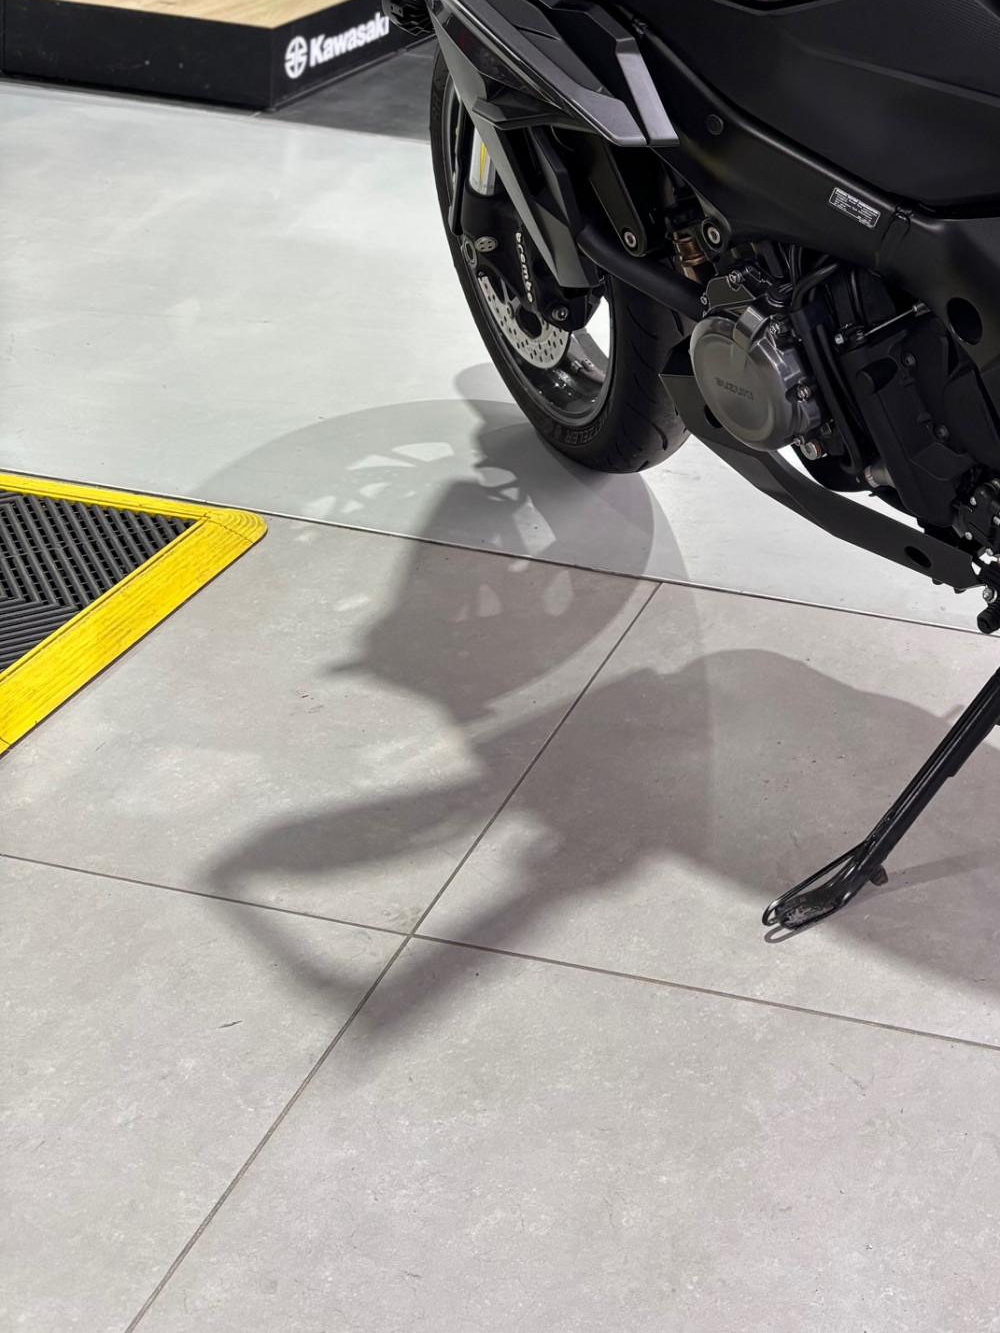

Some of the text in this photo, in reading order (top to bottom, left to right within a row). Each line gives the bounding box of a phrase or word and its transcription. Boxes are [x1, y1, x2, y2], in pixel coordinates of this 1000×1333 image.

[309, 11, 390, 68] Kawasaki
[515, 232, 533, 303] brembo
[714, 376, 754, 401] SUZUKI
